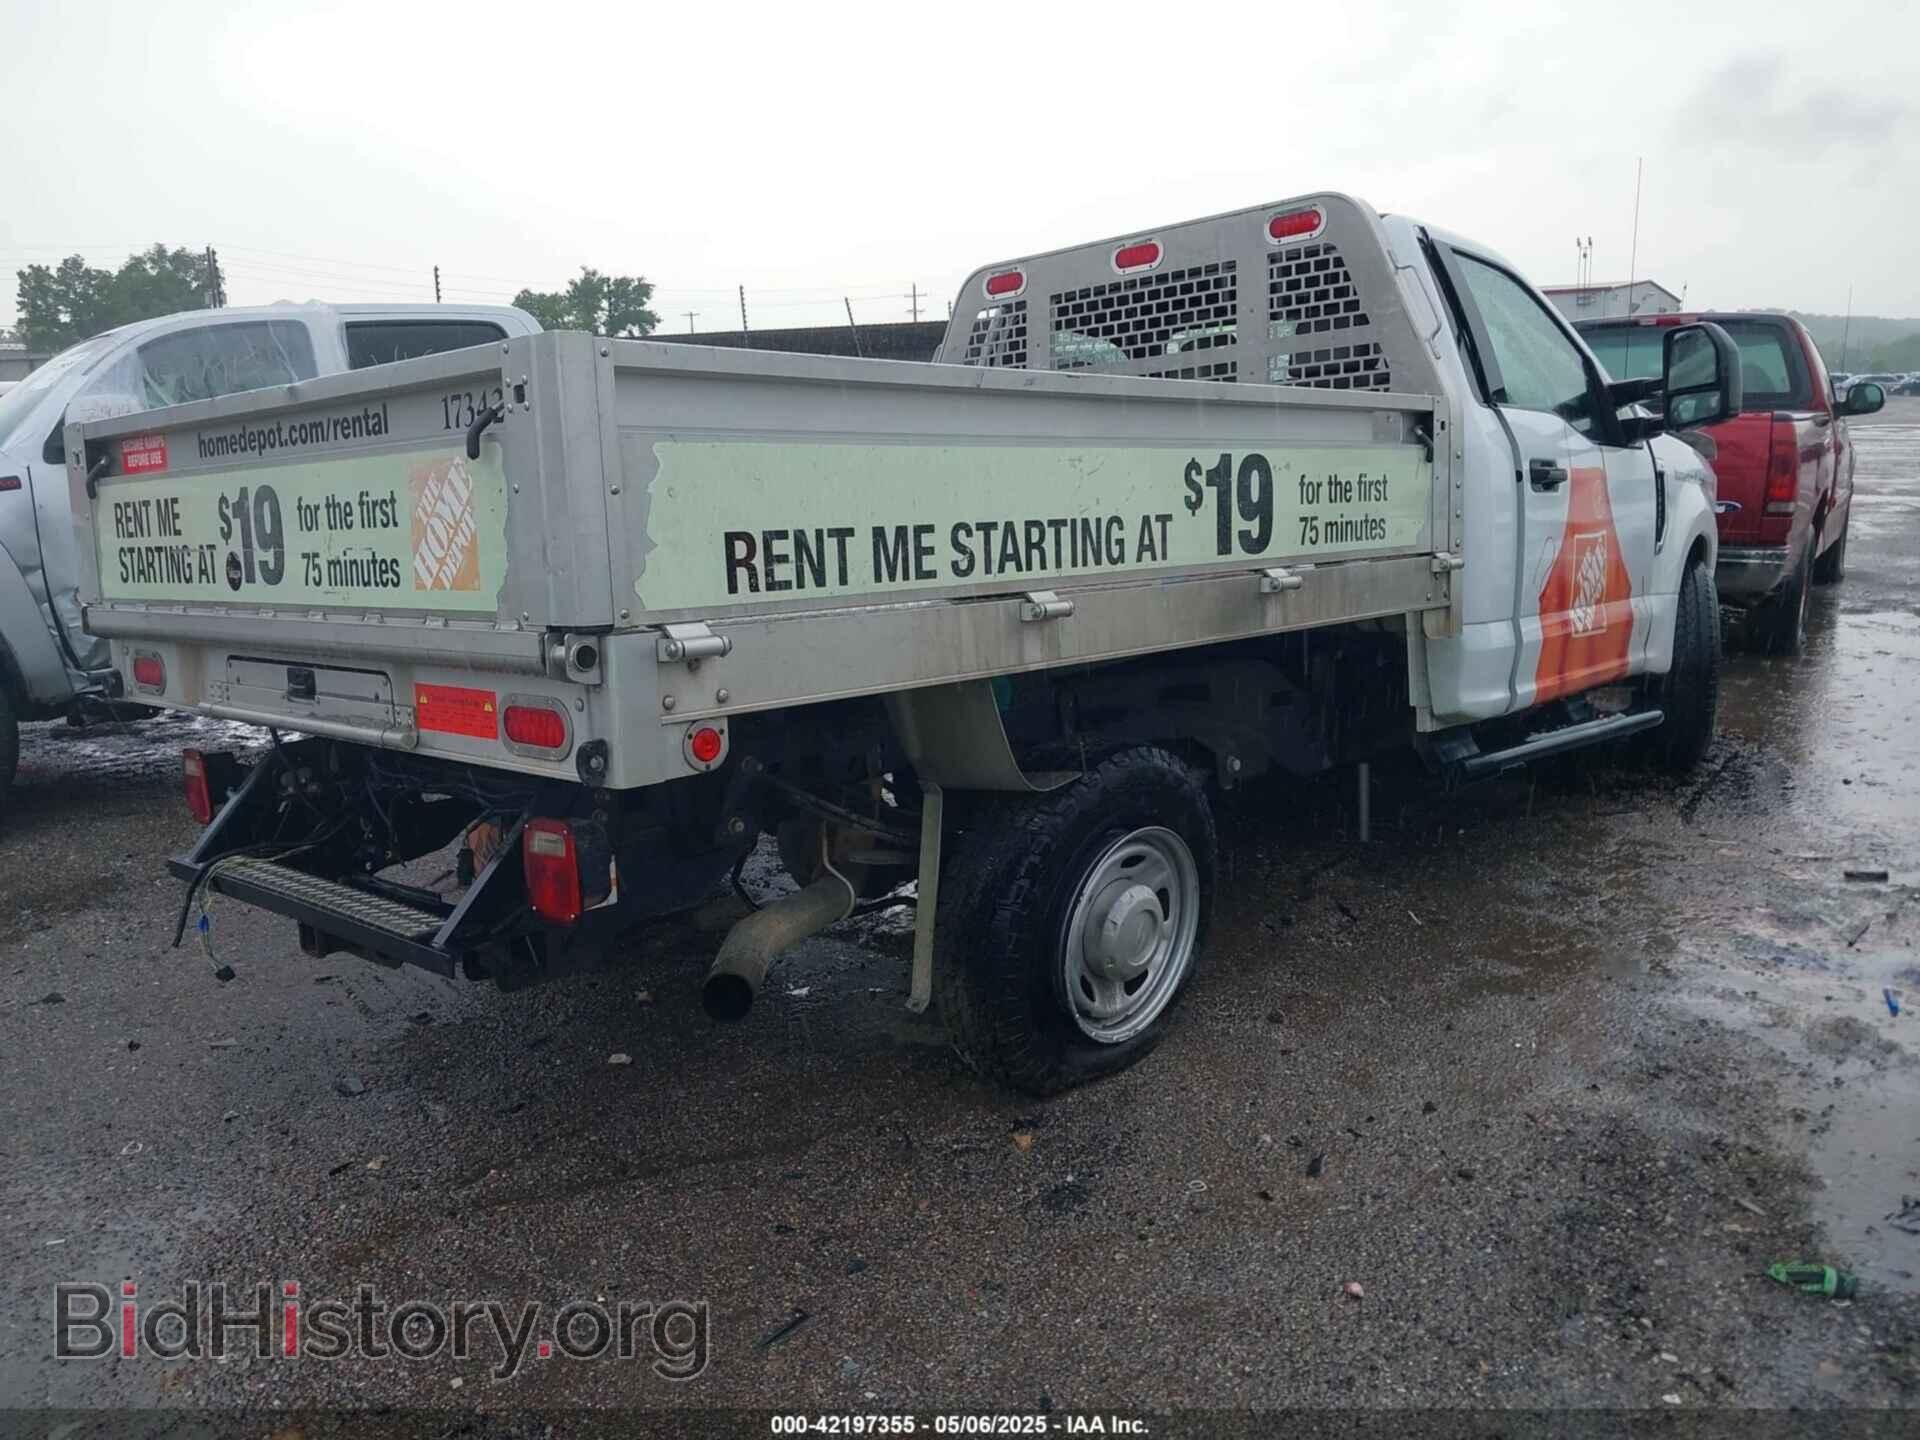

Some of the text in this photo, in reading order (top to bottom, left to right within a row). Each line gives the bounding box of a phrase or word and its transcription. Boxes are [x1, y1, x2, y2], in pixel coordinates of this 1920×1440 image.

[197, 403, 389, 458] homedepot.com/rental
[1184, 452, 1274, 556] $19
[1299, 473, 1388, 505] for the first
[114, 497, 182, 538] RENT ME
[297, 490, 399, 532] for the first
[1299, 513, 1386, 546] 75 minutes
[218, 484, 285, 586] $19
[724, 513, 1173, 594] RENT ME STARTING AT
[119, 543, 216, 584] STARTING AT
[302, 550, 401, 588] 75 minutes
